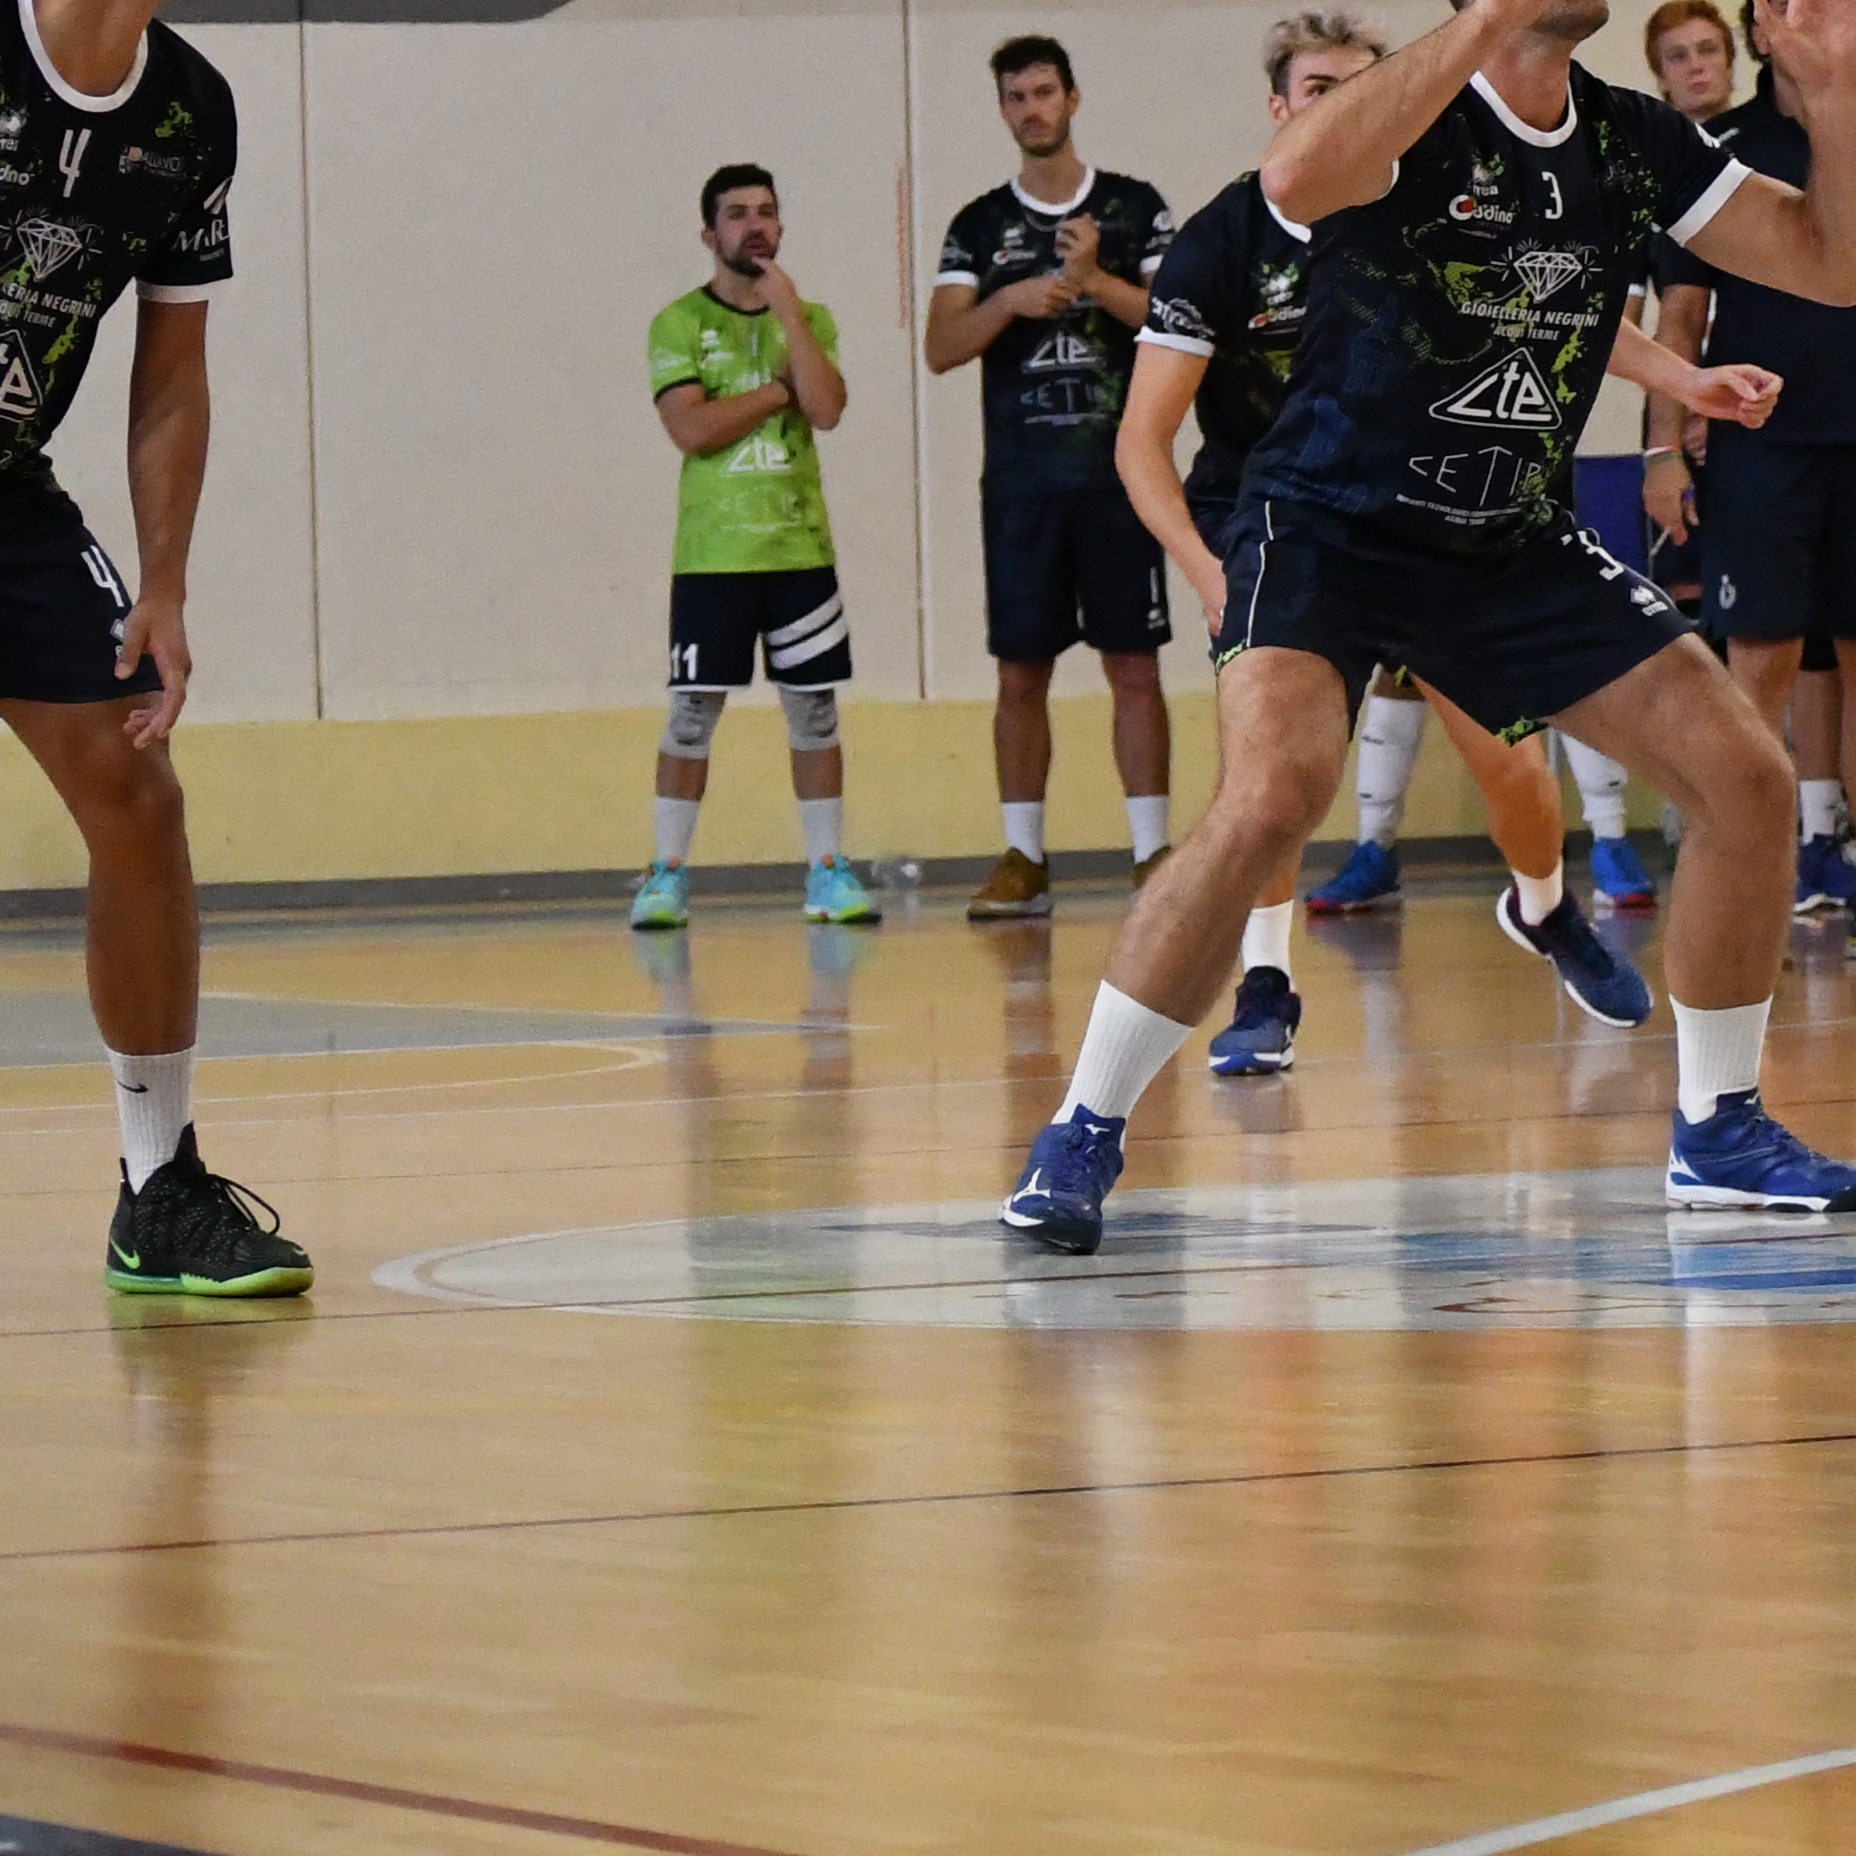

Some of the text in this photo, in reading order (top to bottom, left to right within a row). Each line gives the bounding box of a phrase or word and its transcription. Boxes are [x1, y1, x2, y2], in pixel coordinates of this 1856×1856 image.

[59, 128, 92, 198] 4
[1541, 171, 1564, 220] 3
[44, 290, 98, 320] NEGRINI
[1460, 300, 1600, 328] GIOIELLERIA NEGRINI
[671, 643, 698, 681] 11
